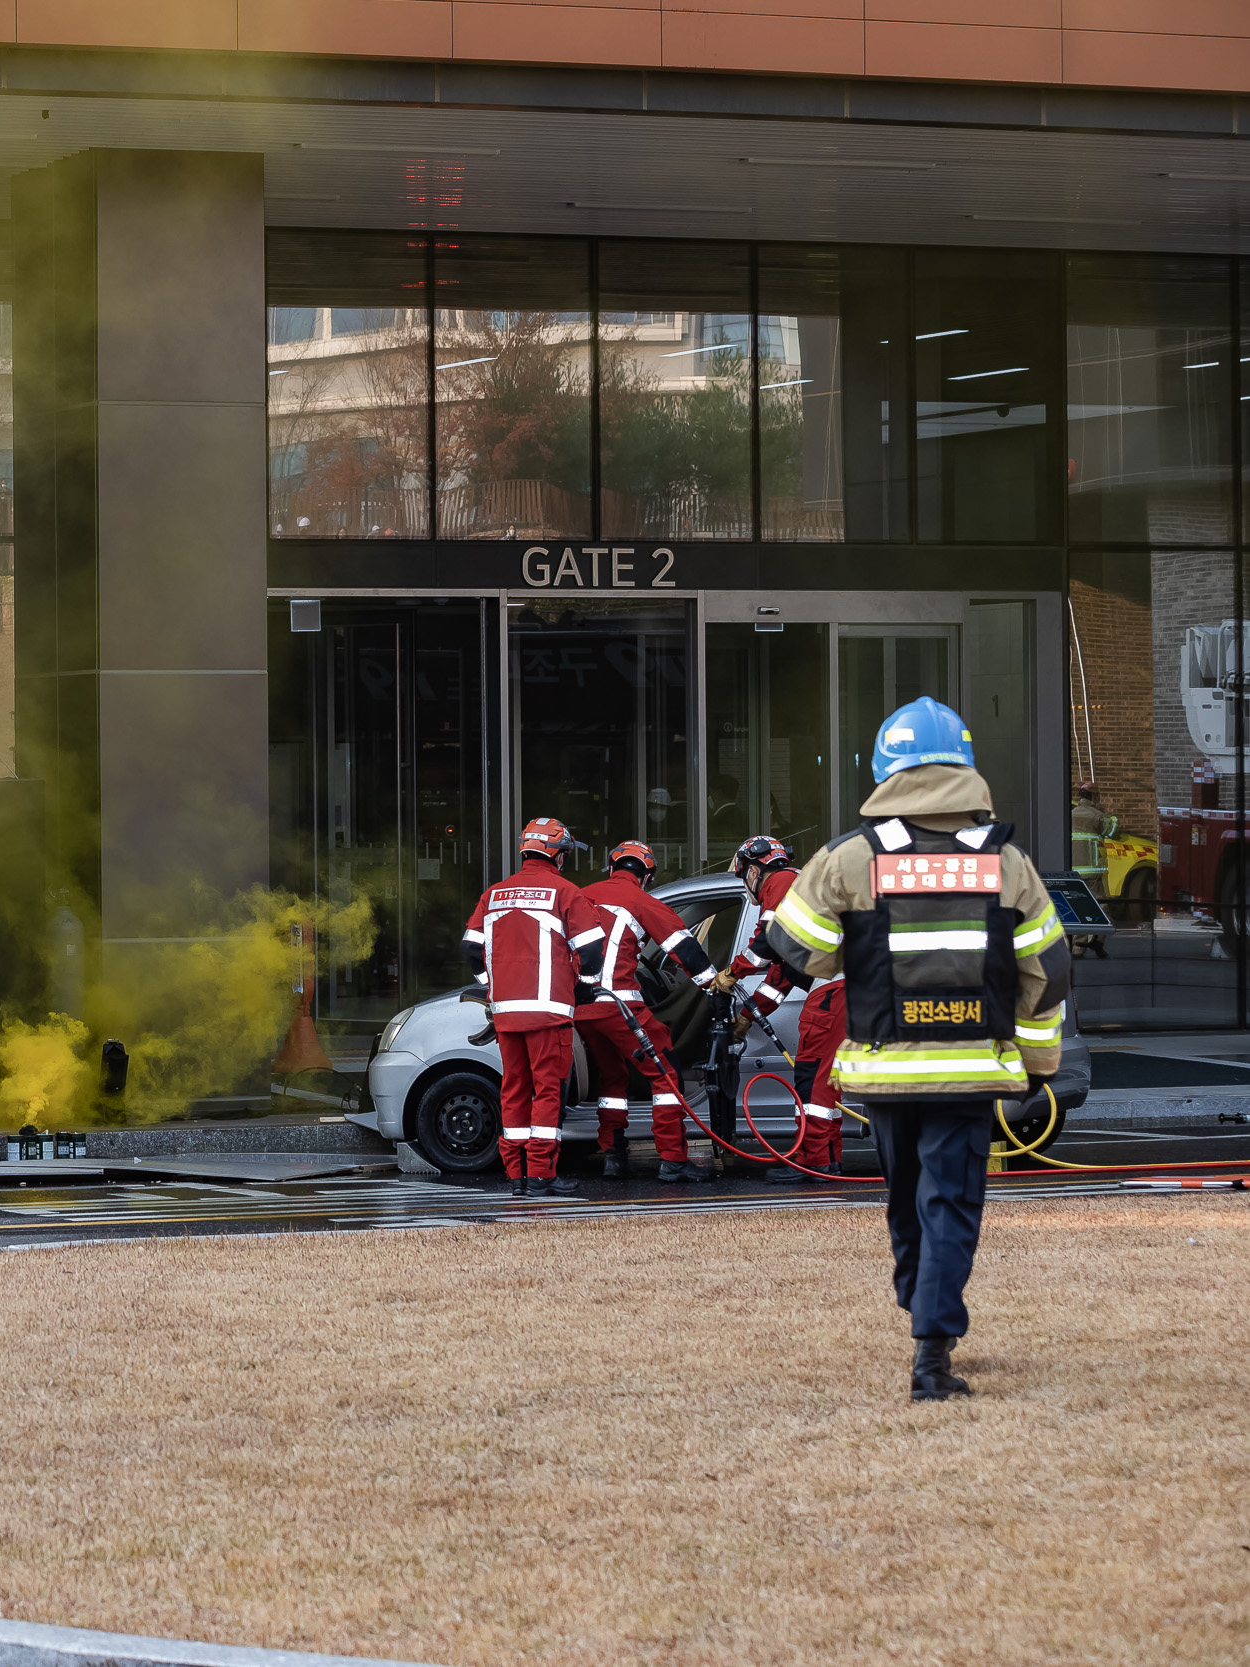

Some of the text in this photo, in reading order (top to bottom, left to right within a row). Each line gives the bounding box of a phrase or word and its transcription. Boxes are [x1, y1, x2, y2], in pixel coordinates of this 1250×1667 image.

[522, 546, 676, 587] GATE 2
[498, 890, 547, 900] 119구조대
[902, 1000, 982, 1024] 광진소방서
